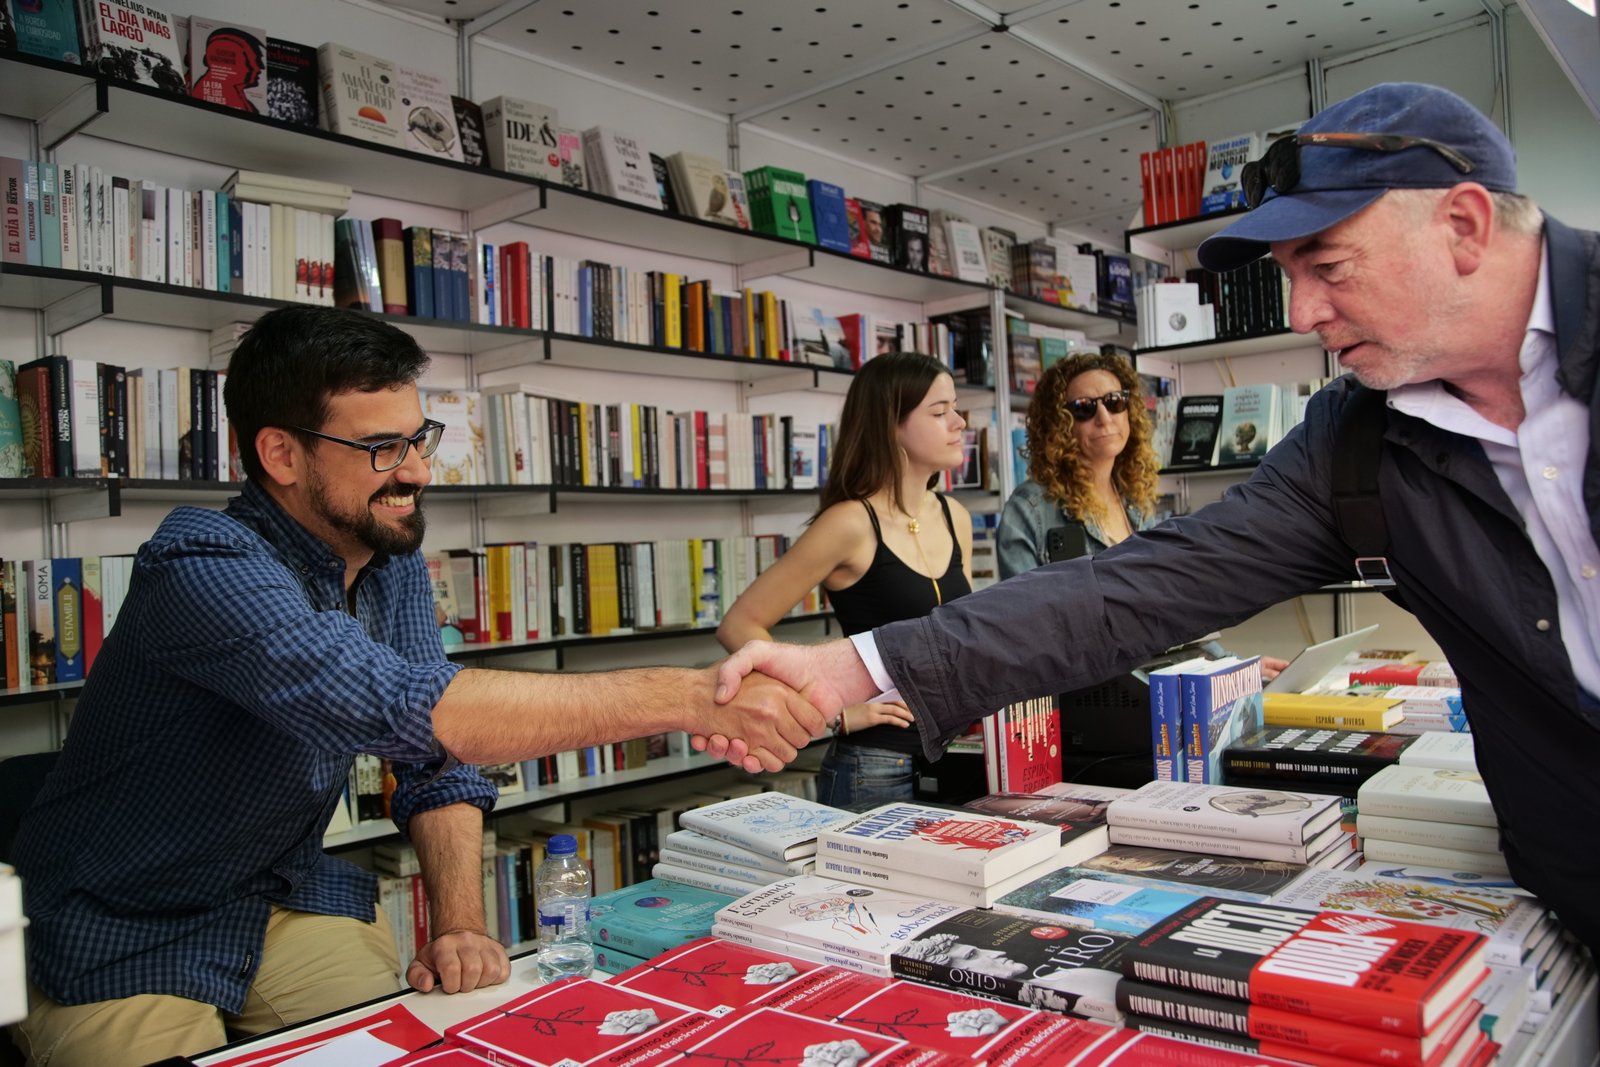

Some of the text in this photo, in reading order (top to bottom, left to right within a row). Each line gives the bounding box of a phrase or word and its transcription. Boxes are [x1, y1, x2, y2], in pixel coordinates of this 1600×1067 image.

[99, 2, 171, 40] EL DÍA MÁS
[147, 8, 168, 24] RYAN
[101, 18, 144, 43] LARGO
[506, 118, 557, 148] IDEAS
[1211, 137, 1250, 152] PEDRO BAÑOS
[1210, 154, 1249, 172] MUNDIAL
[8, 177, 18, 205] BEEVOR
[28, 165, 38, 201] BEEVOR
[64, 169, 72, 195] BEEVOR
[5, 207, 20, 253] EL DÍA D
[28, 201, 36, 241] STALINGRADO
[63, 409, 71, 442] CRUZADA
[38, 565, 49, 601] ROMA
[63, 593, 74, 641] ESTAMBUL
[1210, 659, 1263, 710] DINOSAURIOS
[1315, 713, 1365, 726] ESPAÑA DIVERSA
[1162, 723, 1171, 757] animales
[1194, 723, 1203, 757] animales
[1275, 762, 1359, 776] LA SANGRE QUE MUEVE EL MUNDO
[843, 806, 924, 838] MALDITO
[826, 841, 843, 851] TRABAJO
[844, 844, 862, 855] MALDITO
[872, 851, 889, 860] Eduardo
[825, 862, 843, 872] TRABAJO
[843, 865, 861, 876] MALDITO
[872, 872, 889, 880] Eduardo
[726, 882, 796, 915] Fernando
[742, 891, 796, 919] Savater
[896, 900, 941, 919] Carne
[734, 920, 753, 930] Fernando
[890, 905, 960, 941] gobernada
[1168, 903, 1321, 956] DICTA
[733, 933, 753, 944] Fernando
[822, 941, 860, 957] Carne gobernada
[1044, 943, 1061, 954] EL
[824, 954, 863, 971] Carne gobernada
[898, 959, 933, 971] GREENBLATT
[1033, 934, 1115, 981] GIRO
[1193, 946, 1223, 958] LA
[1258, 929, 1398, 987] DURA
[803, 971, 853, 995] traicionada
[904, 966, 928, 976] STEPHEN
[949, 967, 997, 991] GIRO
[1133, 960, 1249, 999] LA DICTADURA DE LA MINORÍA
[1128, 994, 1248, 1033] LA DICTADURA DE LA MINORÍA
[608, 1015, 707, 1064] Guillermo del Valle
[1023, 1017, 1071, 1049] traicionada
